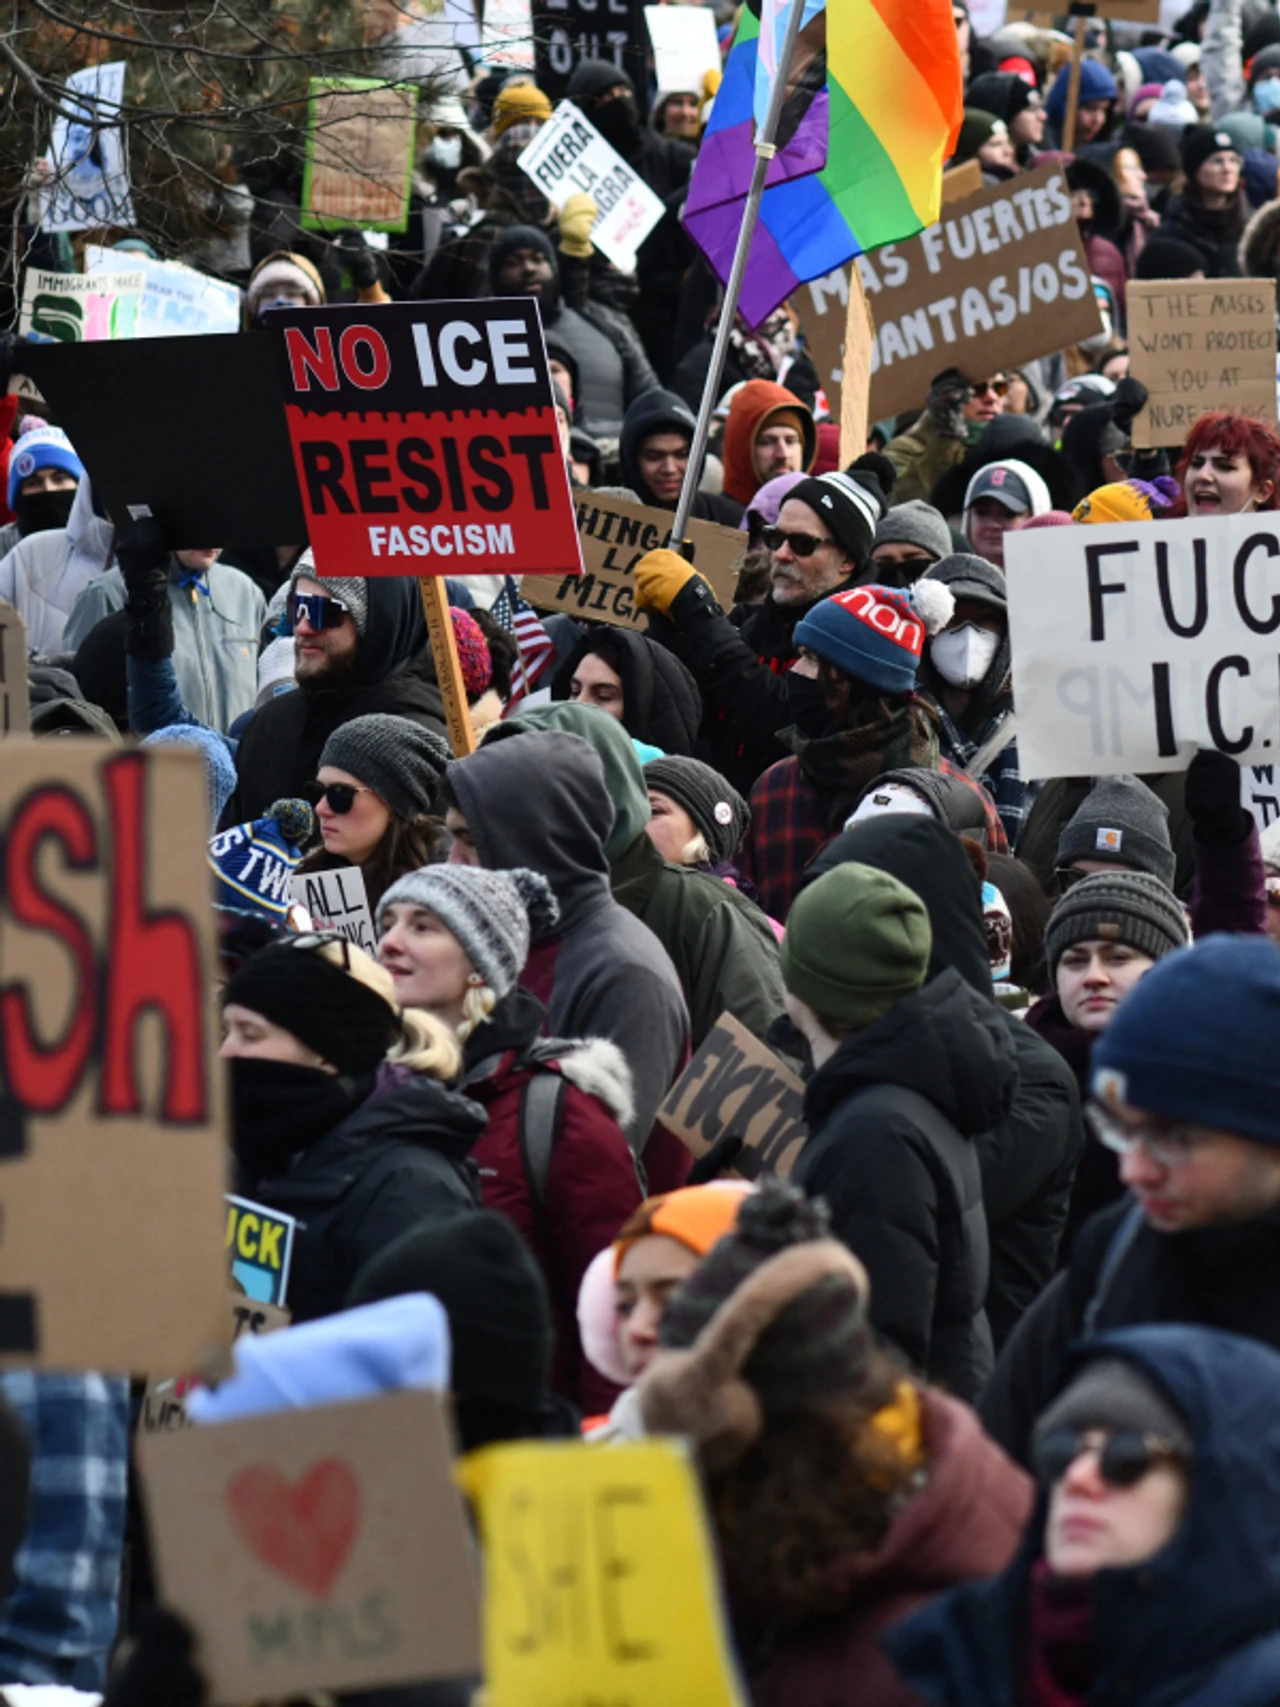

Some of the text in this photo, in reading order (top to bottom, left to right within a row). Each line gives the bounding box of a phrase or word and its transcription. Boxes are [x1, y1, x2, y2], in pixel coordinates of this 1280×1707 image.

[536, 121, 594, 191] FUERA
[568, 162, 599, 193] LA
[592, 165, 635, 229] IGRA
[920, 175, 1072, 274] FUERTES
[1140, 294, 1265, 317] THE MASKS
[284, 319, 537, 391] NO ICE
[1168, 367, 1240, 391] YOU AT
[299, 434, 555, 515] RESIST
[368, 523, 515, 556] FASCISM
[305, 874, 363, 918] ALL
